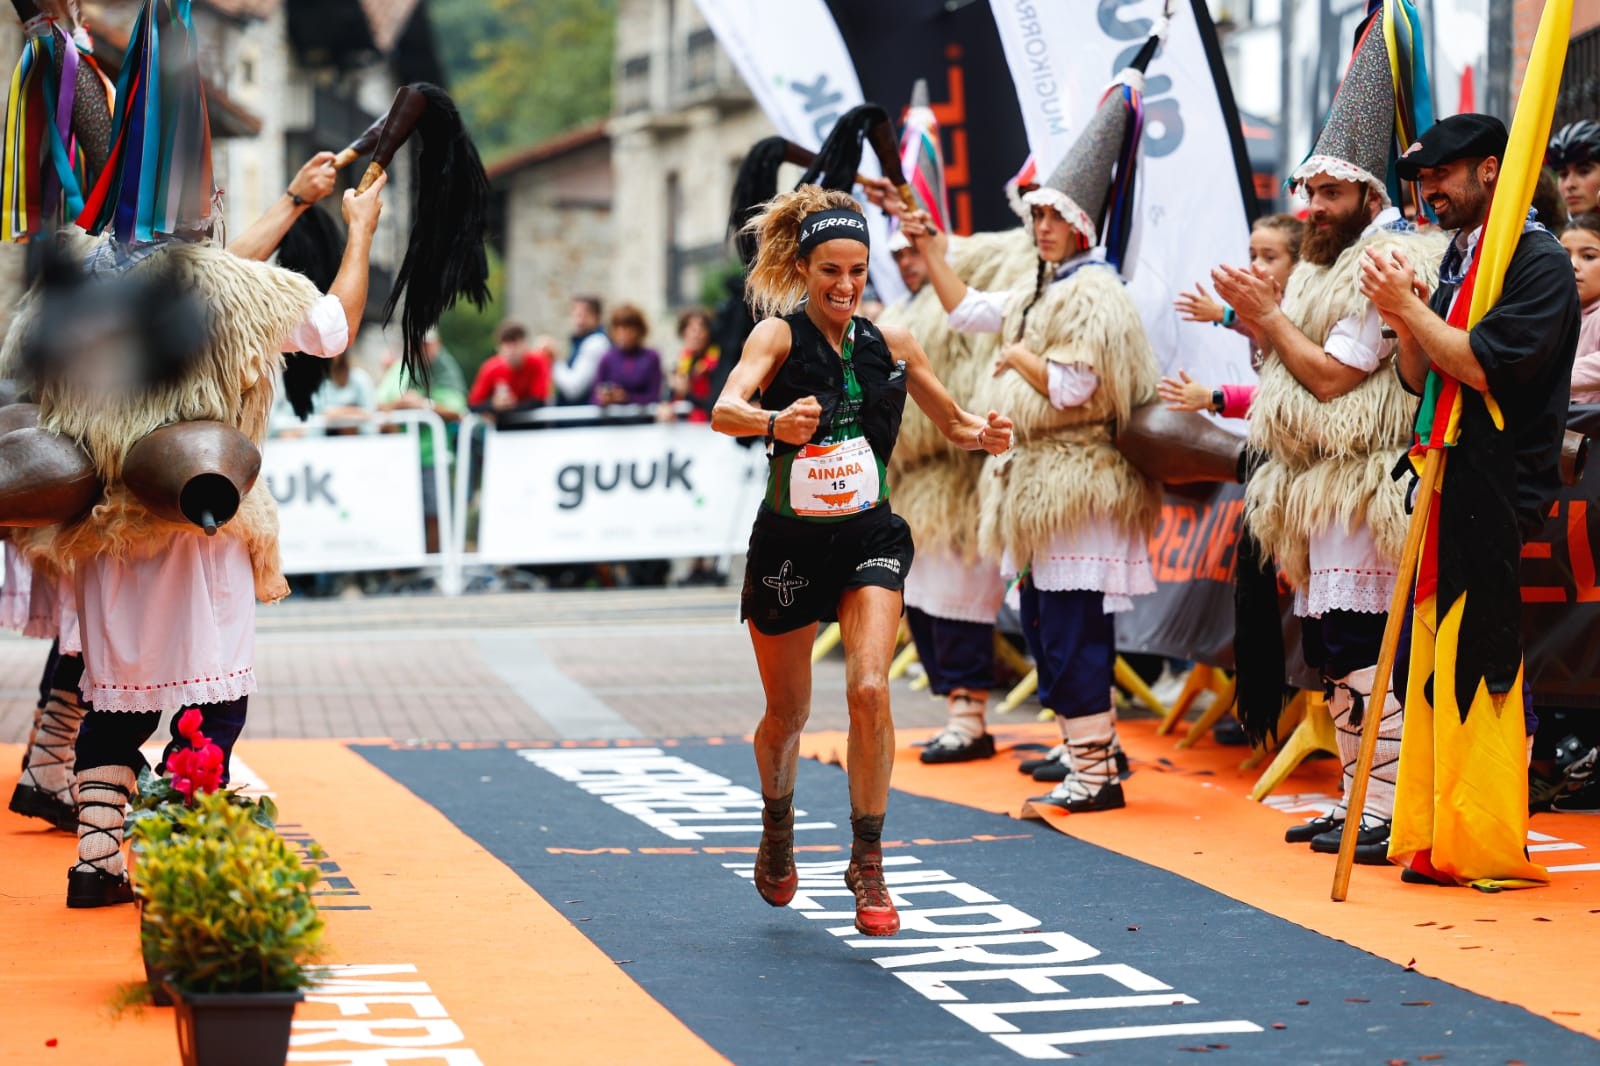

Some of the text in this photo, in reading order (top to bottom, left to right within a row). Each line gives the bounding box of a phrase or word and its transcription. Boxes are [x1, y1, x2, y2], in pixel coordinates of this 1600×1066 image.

[811, 217, 865, 235] TERREX
[807, 462, 864, 480] AINARA
[831, 480, 847, 491] 15
[720, 855, 1266, 1060] MERRELL
